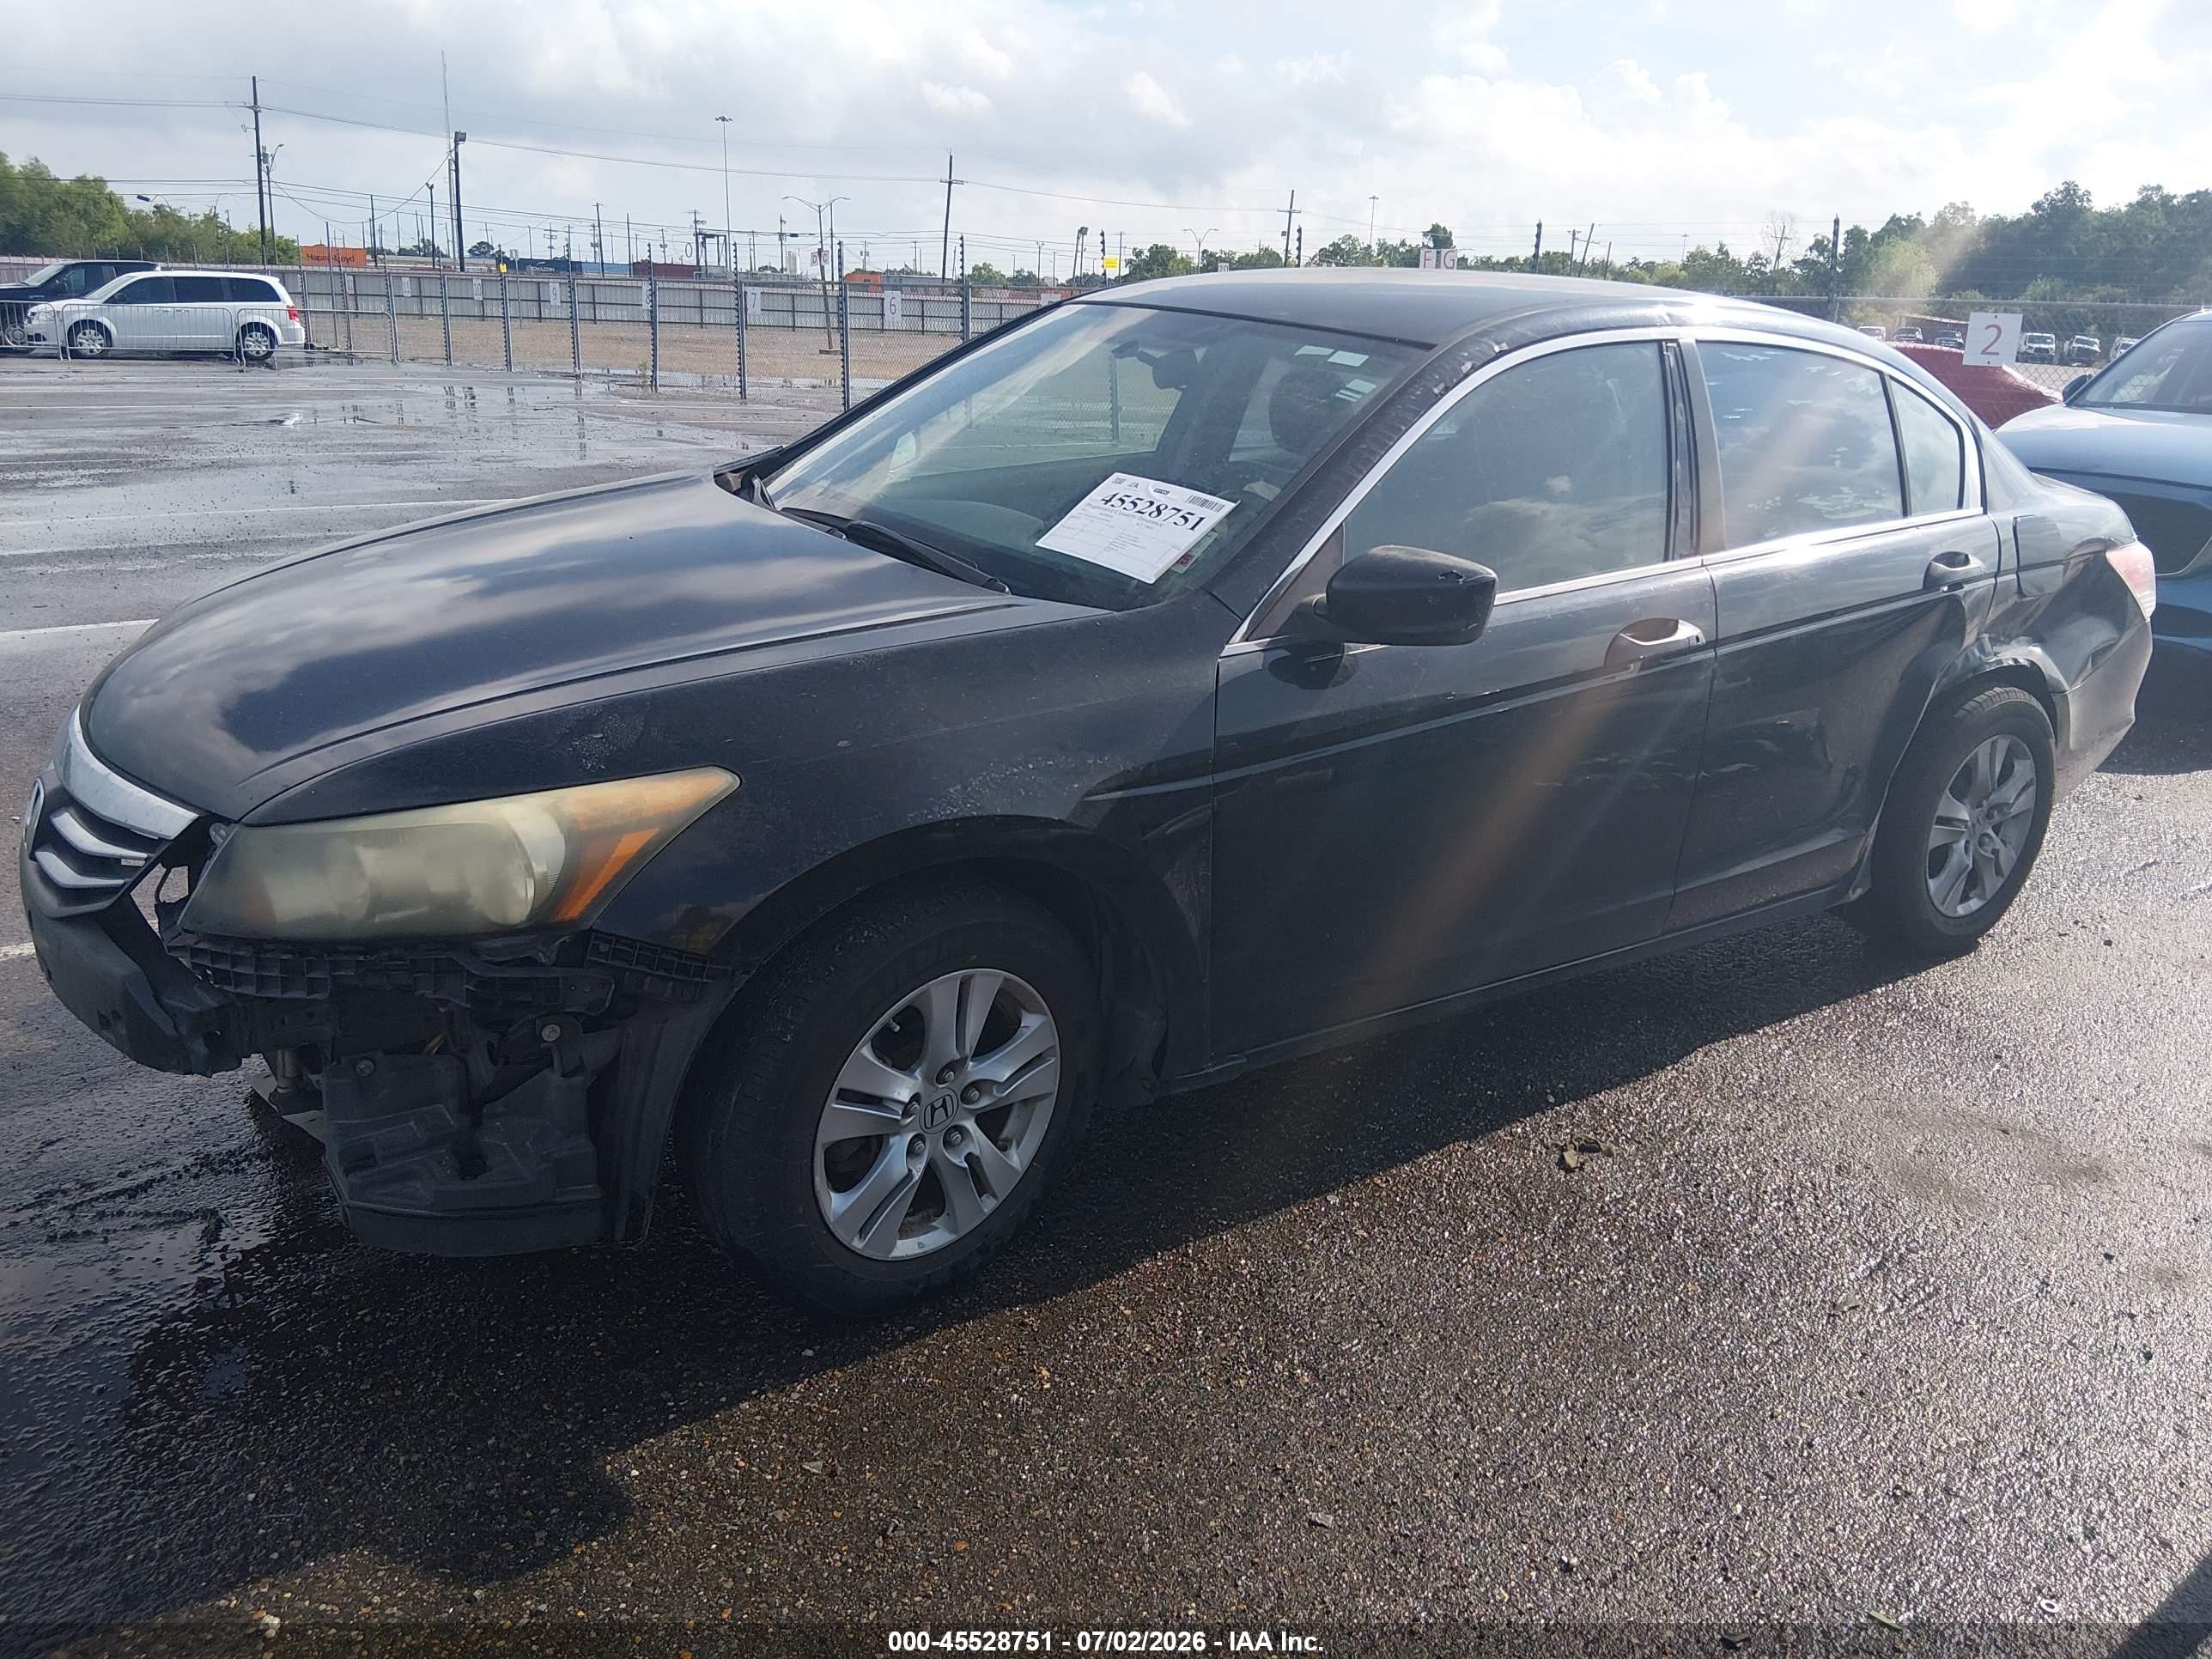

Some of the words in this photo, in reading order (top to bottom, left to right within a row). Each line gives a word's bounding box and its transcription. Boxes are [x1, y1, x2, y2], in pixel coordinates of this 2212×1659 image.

[812, 254, 817, 264] D
[823, 252, 829, 263] C
[1423, 250, 1432, 269] F
[1443, 250, 1456, 270] G
[473, 283, 482, 295] 10
[552, 287, 557, 301] 9
[750, 292, 757, 308] 7
[890, 296, 896, 315] 6
[1980, 324, 2002, 356] 2
[1100, 491, 1206, 532] 45528751
